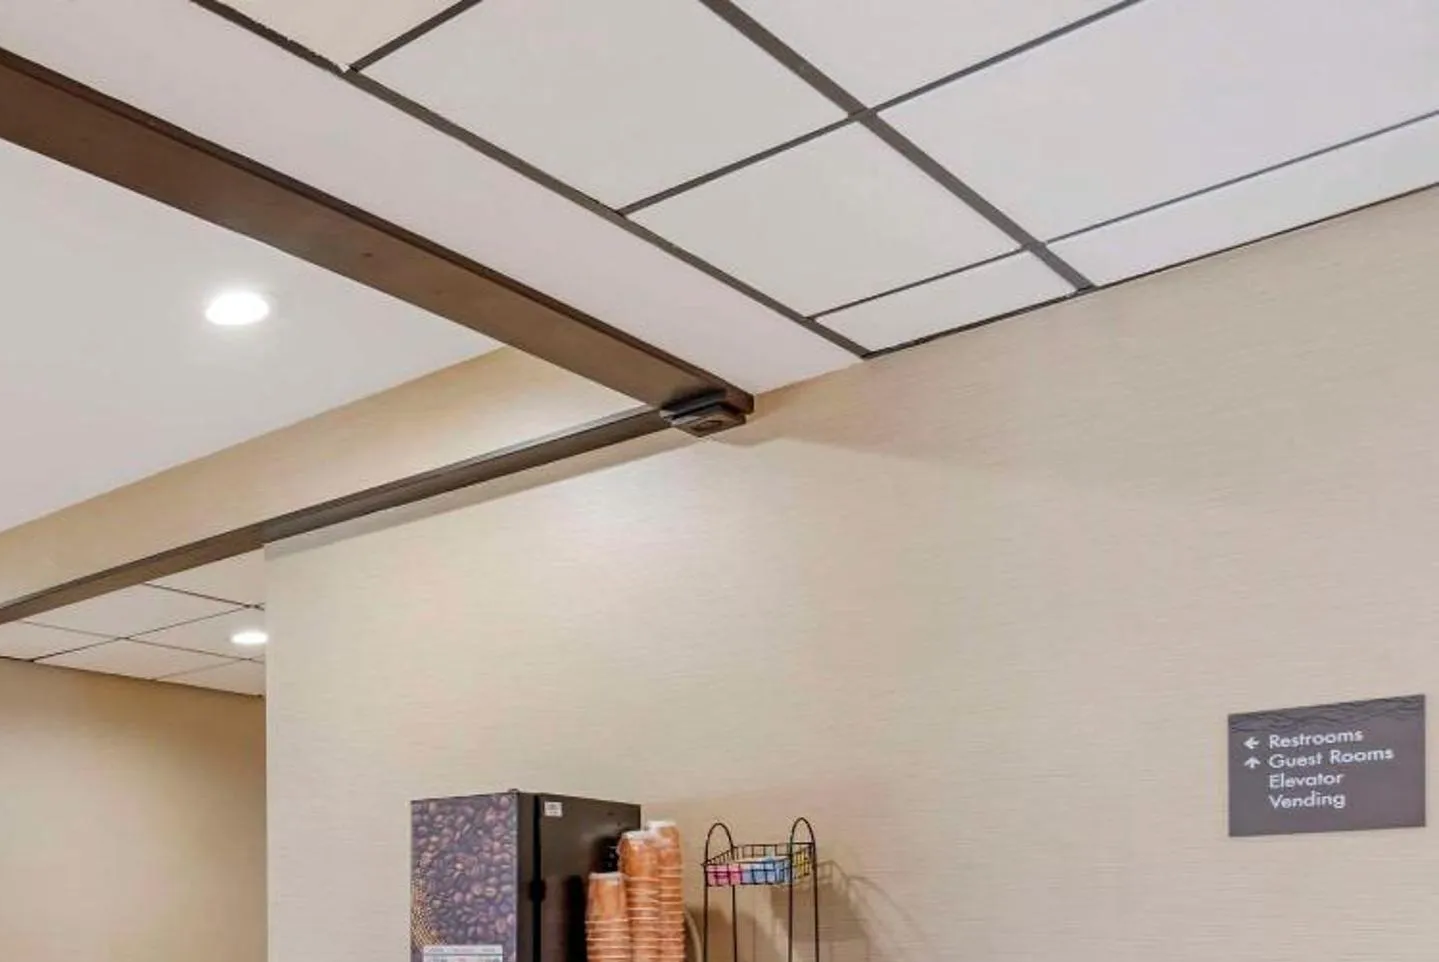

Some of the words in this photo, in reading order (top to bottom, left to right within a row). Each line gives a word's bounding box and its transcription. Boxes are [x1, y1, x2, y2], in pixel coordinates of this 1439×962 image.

[1269, 730, 1364, 749] Restrooms
[1268, 752, 1323, 768] Guest
[1330, 748, 1394, 764] Rooms
[1269, 772, 1345, 789] Elevator
[1268, 790, 1346, 809] Vending
